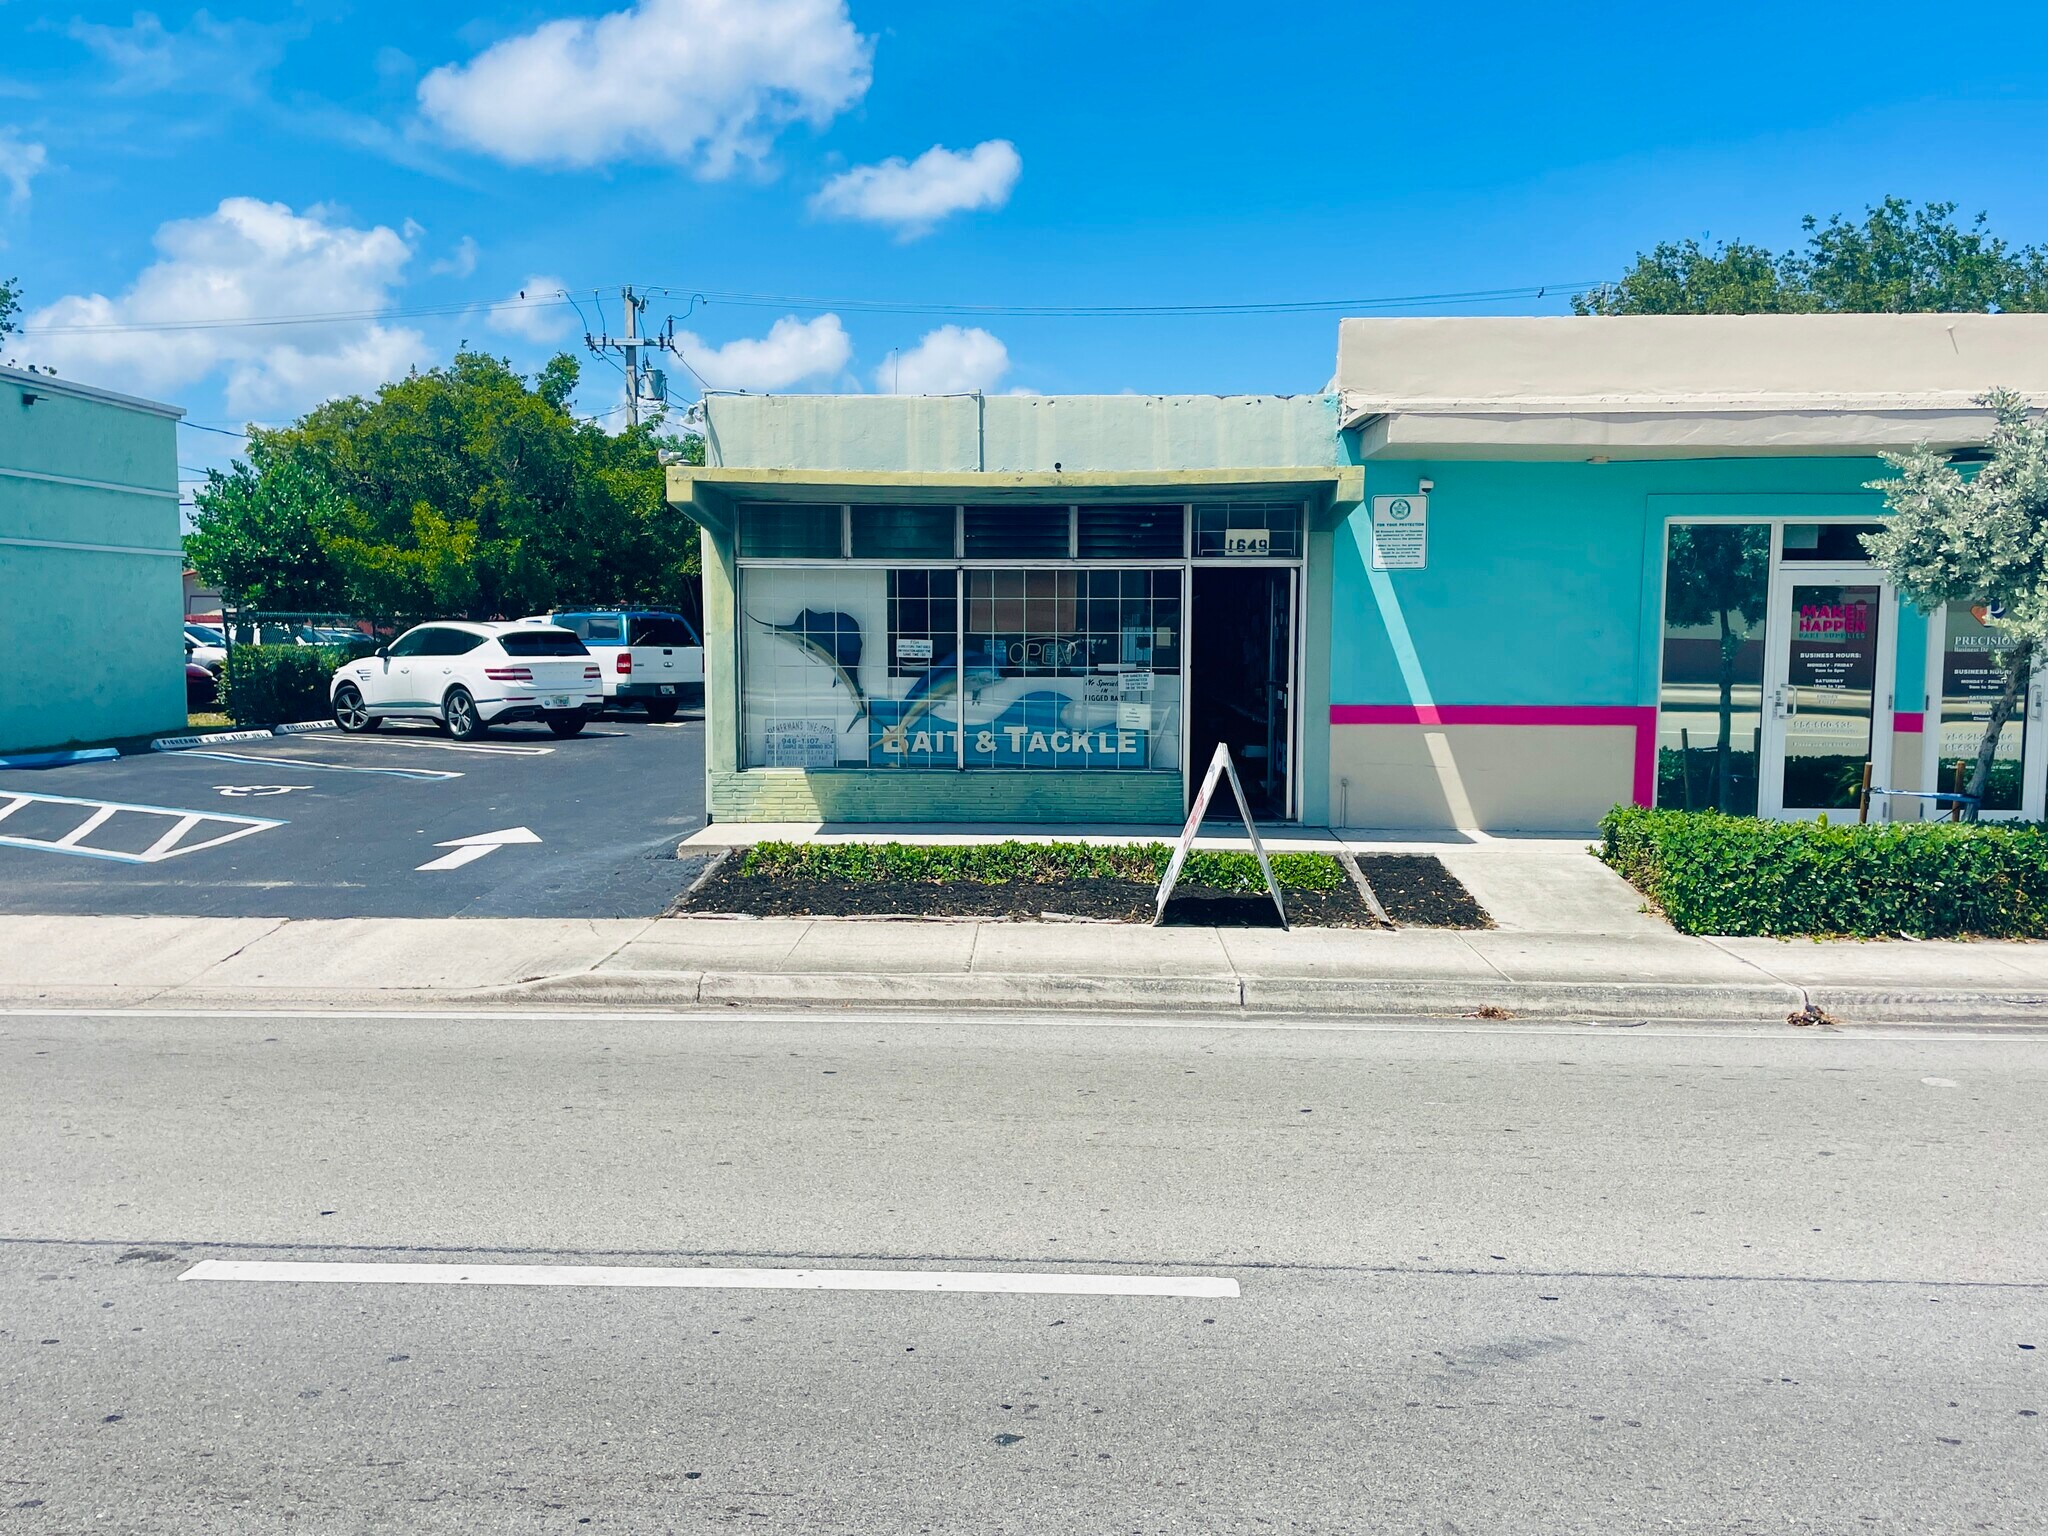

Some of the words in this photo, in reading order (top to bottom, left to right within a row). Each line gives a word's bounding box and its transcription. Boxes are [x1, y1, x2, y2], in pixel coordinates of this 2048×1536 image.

[1228, 538, 1268, 553] 1649
[1800, 604, 1856, 619] MAKE
[1799, 620, 1867, 633] HAPPEN
[1009, 643, 1072, 664] OPEN
[882, 726, 967, 753] BAIT
[975, 730, 998, 753] &
[1003, 726, 1137, 753] TACKLE
